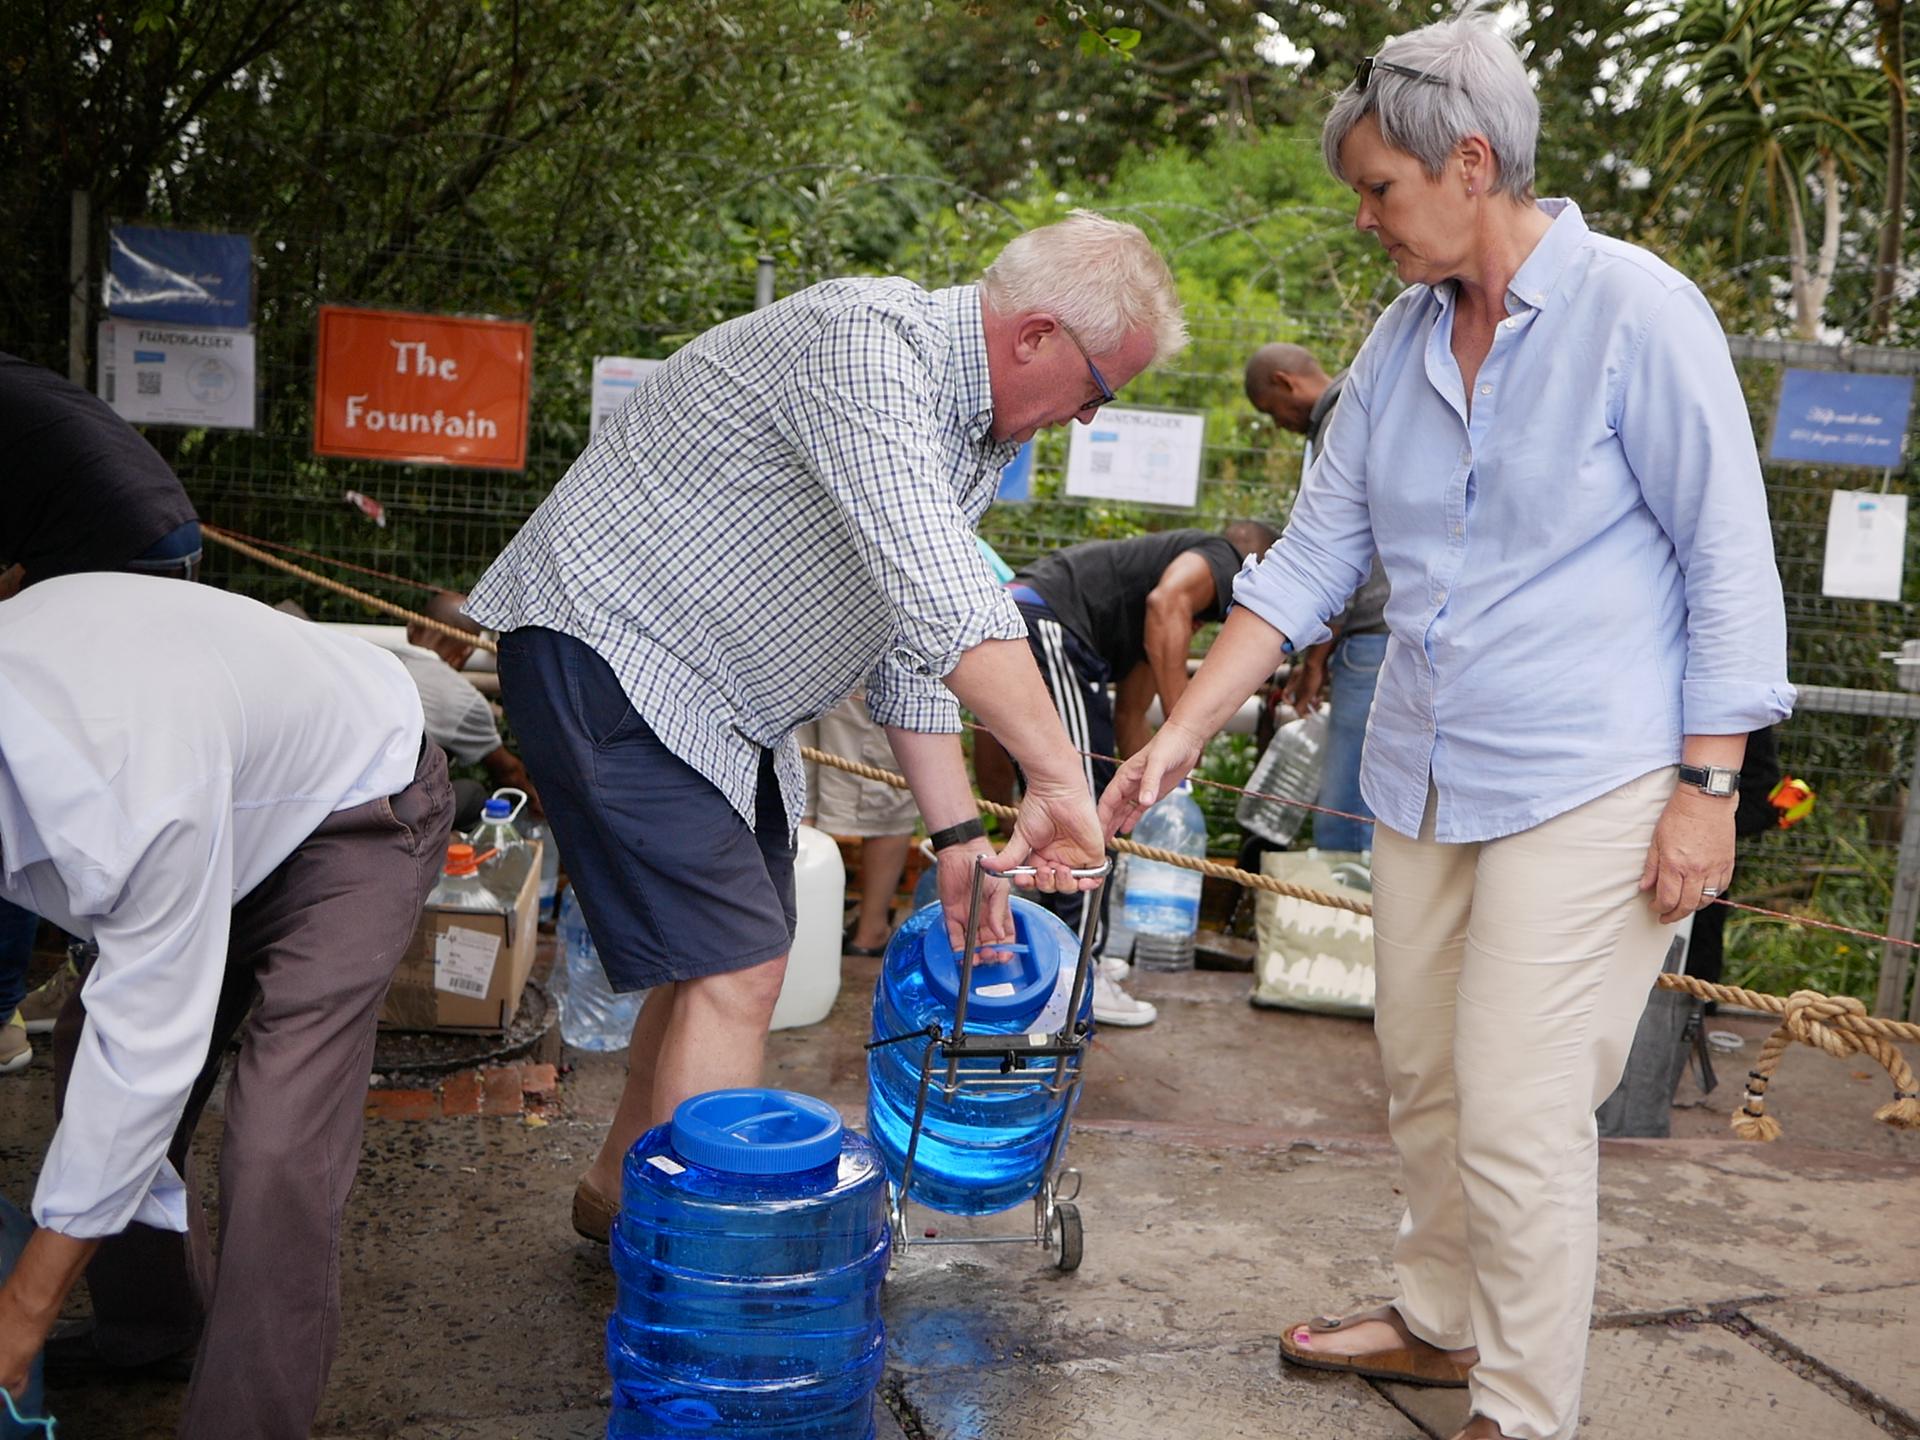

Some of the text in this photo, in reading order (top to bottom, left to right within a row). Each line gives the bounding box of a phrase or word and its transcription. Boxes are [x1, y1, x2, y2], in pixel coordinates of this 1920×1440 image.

[138, 330, 233, 349] FUNDRAISER
[391, 338, 458, 380] The
[345, 393, 497, 440] Fountain
